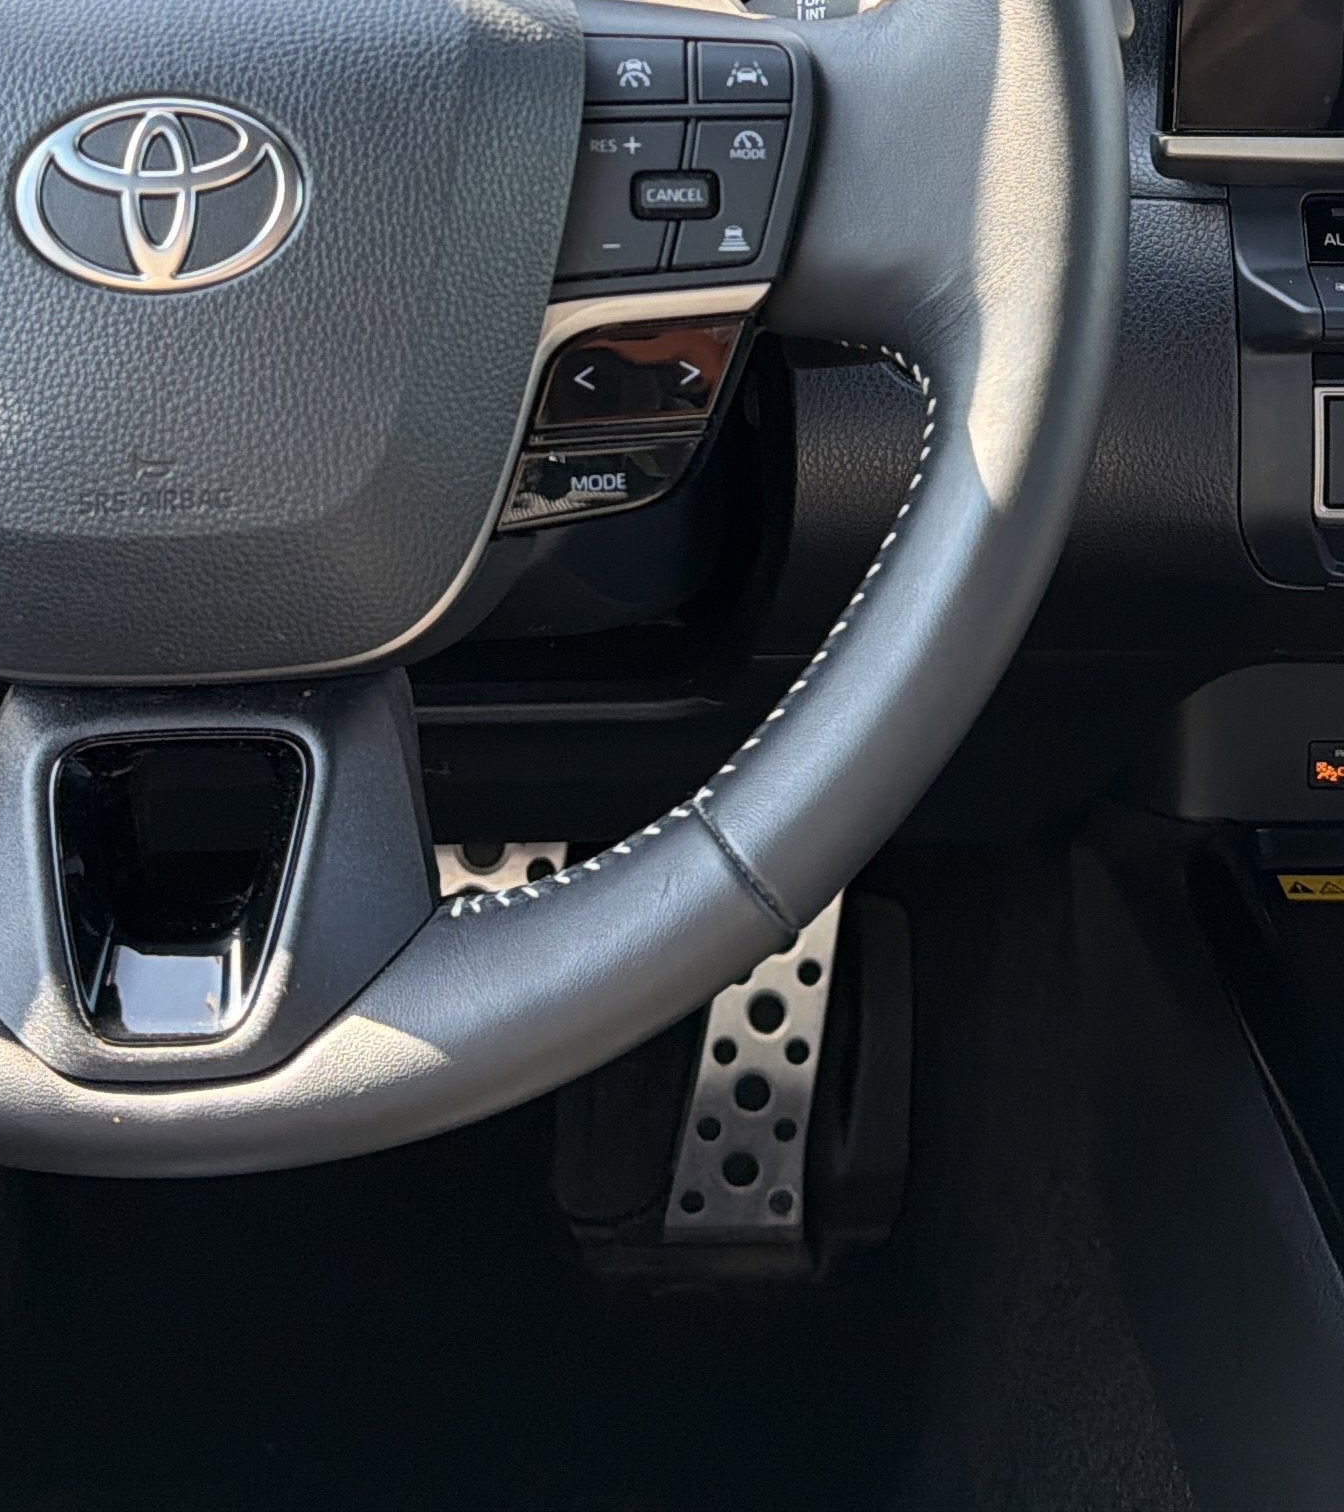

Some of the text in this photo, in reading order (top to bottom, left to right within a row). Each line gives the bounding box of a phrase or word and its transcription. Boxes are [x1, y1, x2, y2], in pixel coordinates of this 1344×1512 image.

[805, 6, 827, 20] INT
[589, 139, 618, 154] RES
[730, 147, 767, 161] MODE
[646, 188, 706, 203] CANCEL
[570, 472, 627, 492] MODE
[134, 488, 234, 513] AIRBAG
